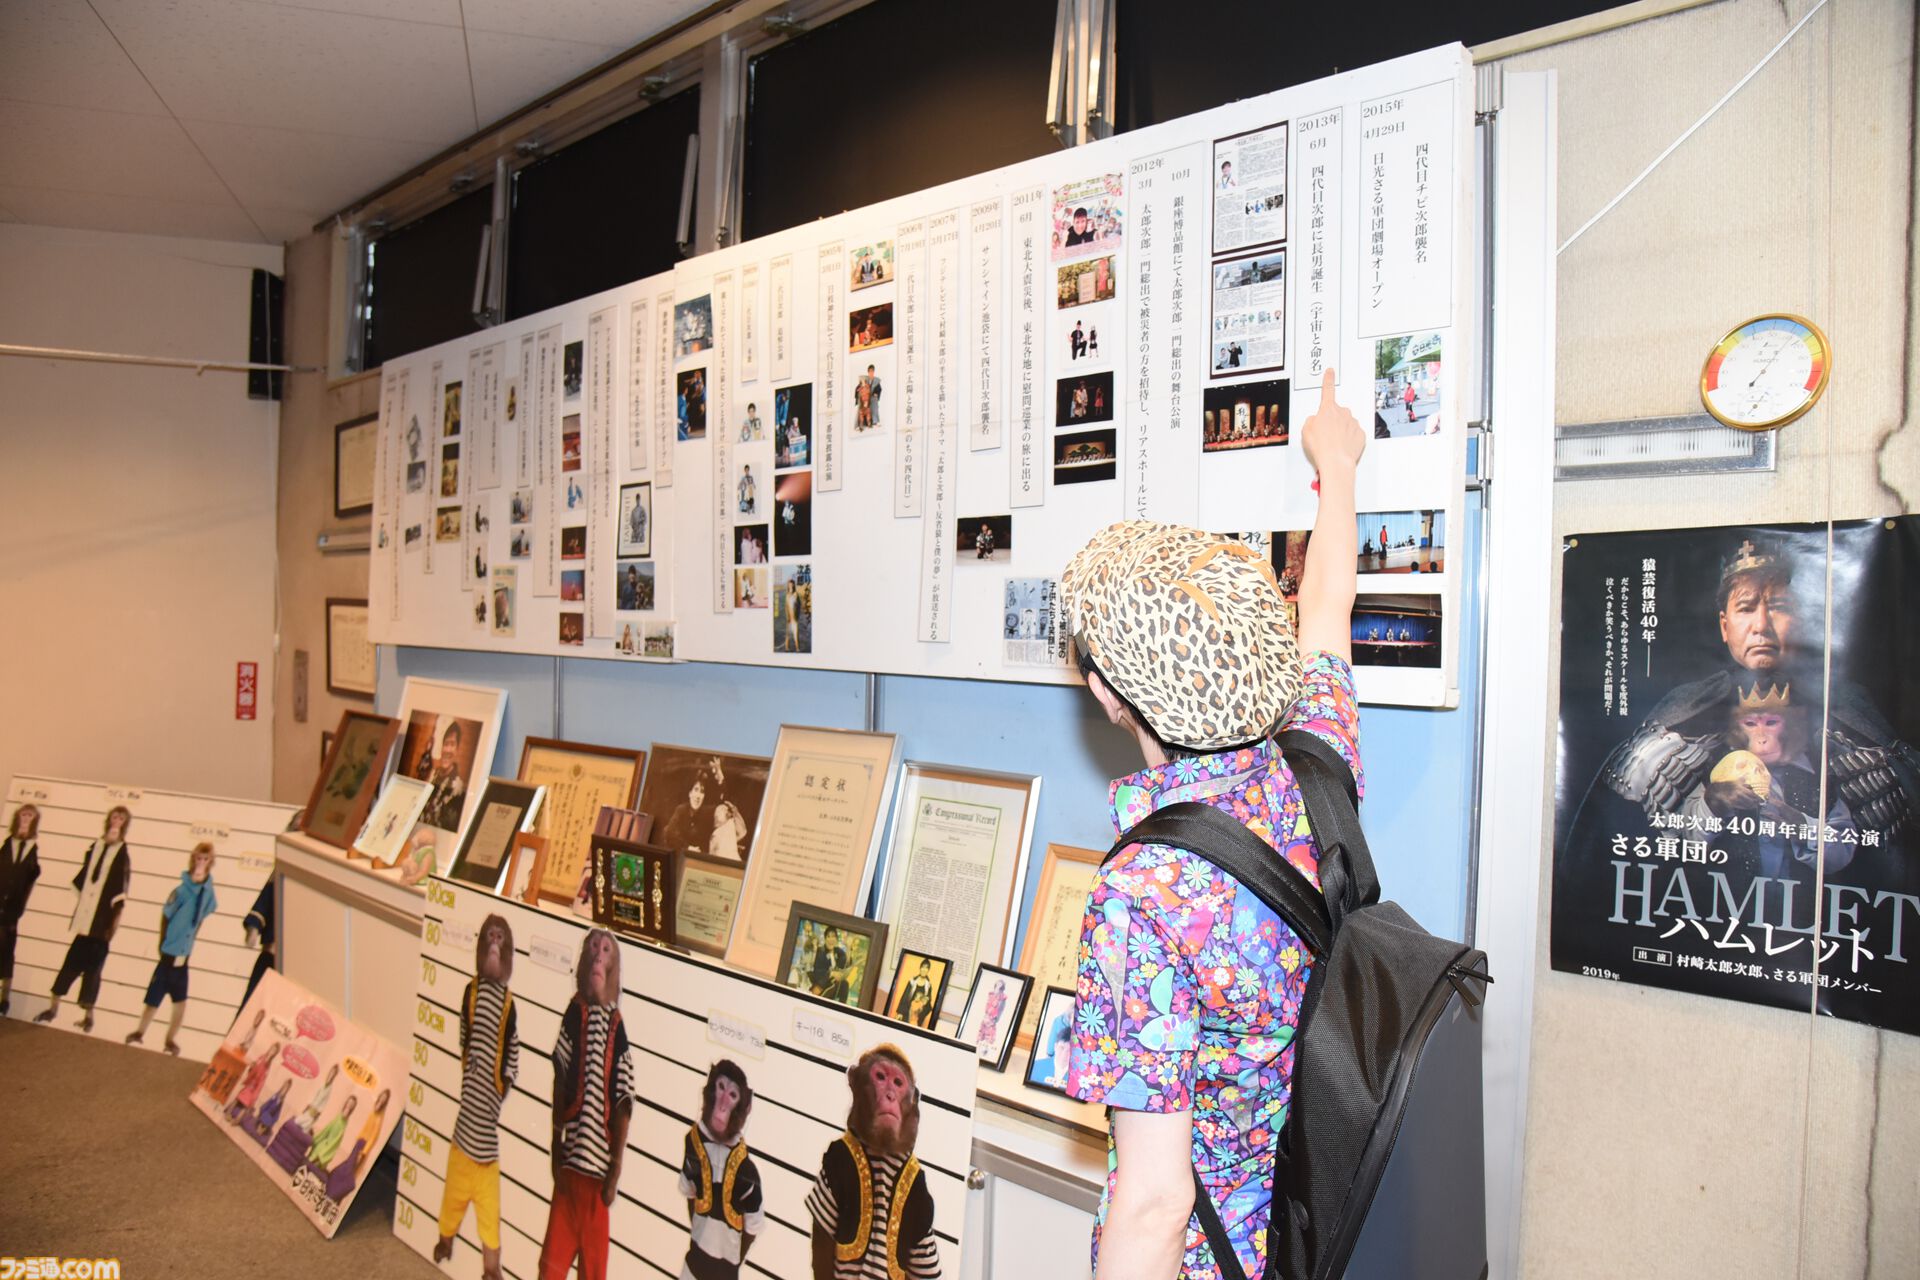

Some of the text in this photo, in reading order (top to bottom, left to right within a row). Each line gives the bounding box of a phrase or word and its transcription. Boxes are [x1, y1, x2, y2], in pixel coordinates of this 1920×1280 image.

[1363, 99, 1404, 118] 2015年
[1299, 113, 1341, 132] 2013年
[1363, 121, 1405, 139] 4月29日
[1309, 137, 1327, 150] 6月
[1131, 157, 1165, 175] 2012年
[1171, 168, 1191, 182] 10月
[1014, 190, 1042, 207] 2011年
[1415, 143, 1429, 263] 四代目チビ次郎襲名
[1371, 152, 1385, 309] 日光さる軍団劇場オープン
[1619, 577, 1630, 717] だからこそ、あらゆるスケールを度外視
[1649, 811, 1881, 848] 太郎次郎40周年記念公演
[1610, 833, 1729, 865] さる軍団の
[427, 880, 456, 909] 90cm
[1607, 860, 1920, 963] HAMLET
[426, 921, 441, 946] 80
[1659, 917, 1875, 973] ハムレット
[422, 960, 437, 986] 70
[1581, 965, 1621, 982] 2019年
[417, 1001, 445, 1033] 60cm
[414, 1041, 429, 1066] 50
[409, 1081, 424, 1107] 40
[404, 1118, 433, 1155] 30cm
[402, 1158, 418, 1187] 20
[398, 1200, 414, 1230] 10
